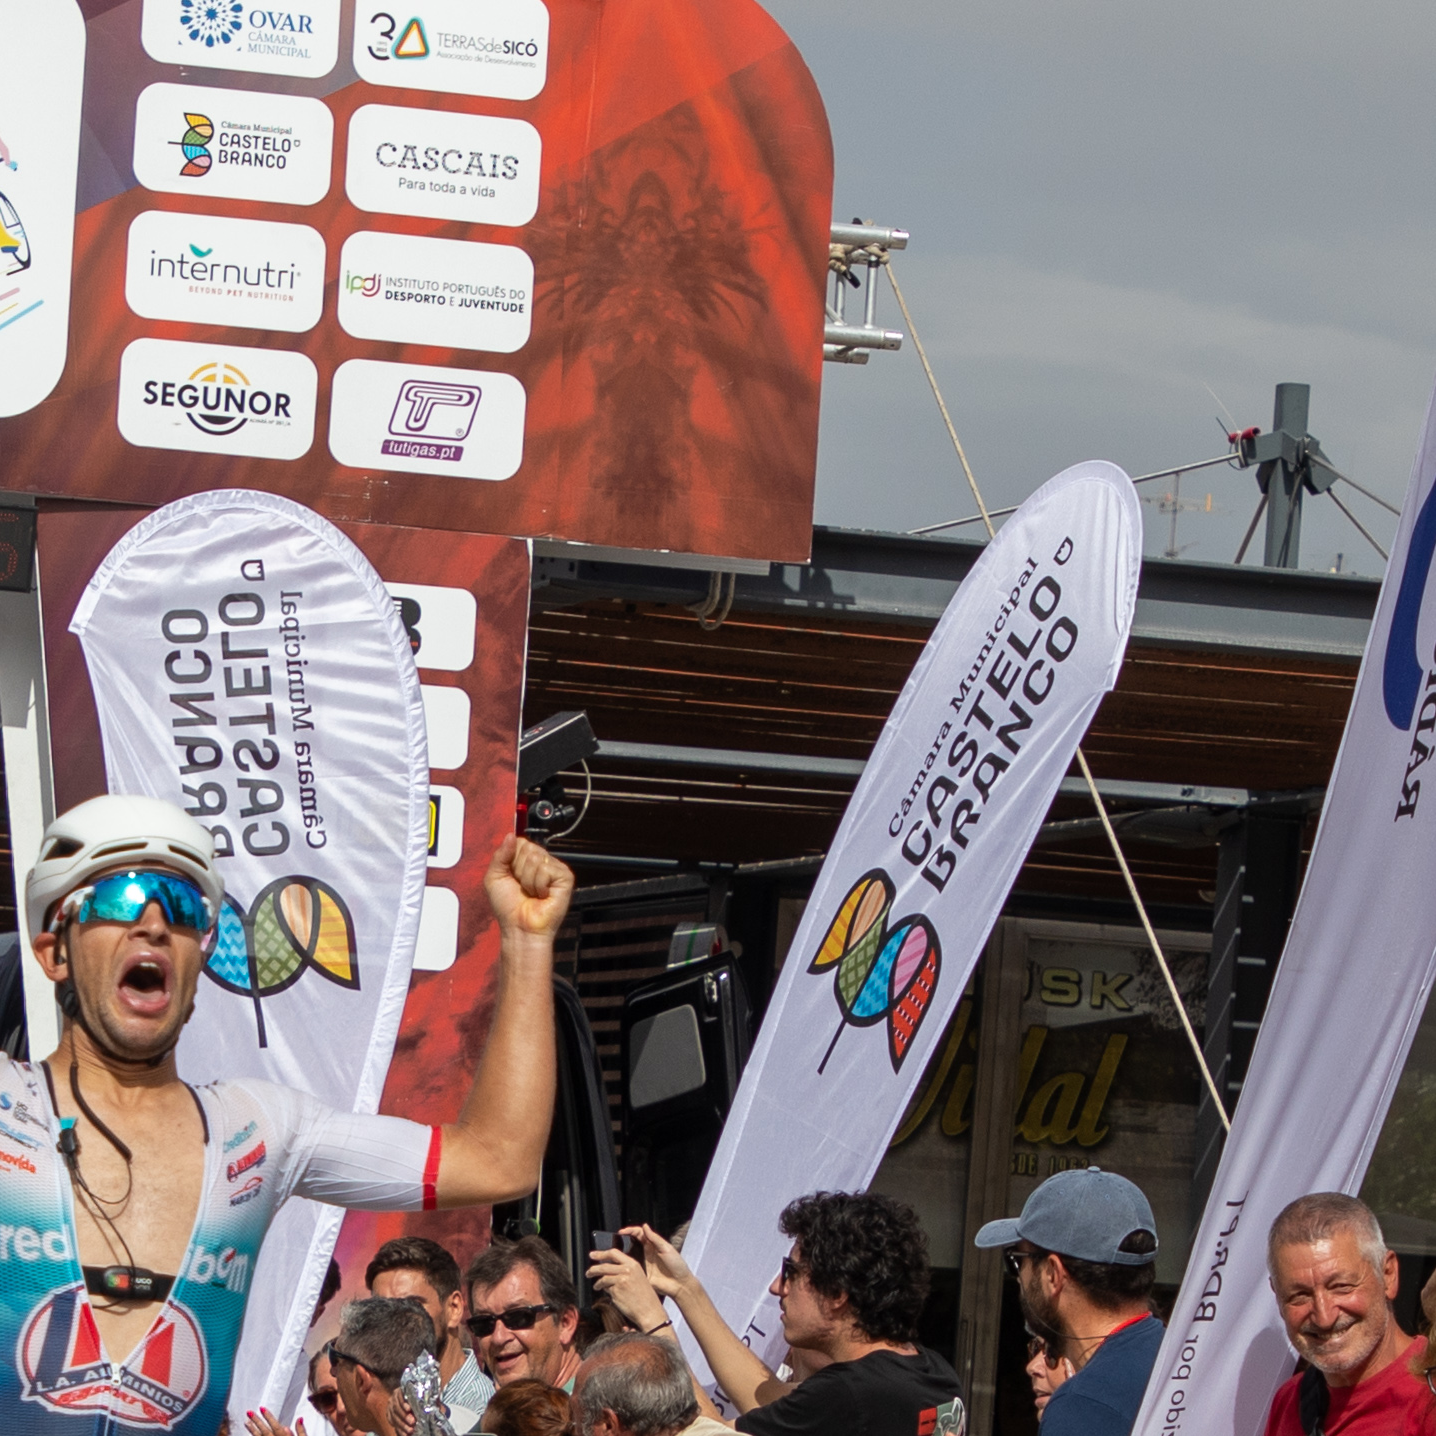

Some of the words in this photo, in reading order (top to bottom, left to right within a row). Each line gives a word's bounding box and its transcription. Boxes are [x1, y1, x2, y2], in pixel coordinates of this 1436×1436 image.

[249, 9, 314, 35] OVAR
[248, 30, 297, 46] CÂMARA
[247, 43, 311, 60] MUNICIPAL
[221, 120, 251, 132] Câmara
[253, 123, 293, 136] Municipal
[219, 133, 291, 153] CASTELO
[218, 149, 287, 170] BRANCO
[375, 141, 521, 181] CASCAIS
[398, 176, 425, 192] Para
[428, 179, 456, 195] toda
[459, 186, 467, 196] a
[470, 183, 496, 198] vida
[149, 249, 296, 290] internutri
[188, 285, 223, 296] BEYOND
[227, 289, 244, 298] PET
[247, 291, 294, 302] NUTRITION
[385, 276, 439, 292] INSTITUTO
[442, 281, 507, 299] PORTUGUÊS
[509, 288, 526, 300] DO
[385, 290, 446, 306] DESPORTO
[458, 297, 525, 314] JUVENTUDE
[143, 380, 291, 418] SEGUNOR
[388, 441, 456, 460] tutigas.pt
[888, 721, 953, 838] Câmara
[949, 557, 1039, 715] Municipal
[901, 576, 1062, 867] CASTELO
[920, 616, 1079, 894] BRANCO
